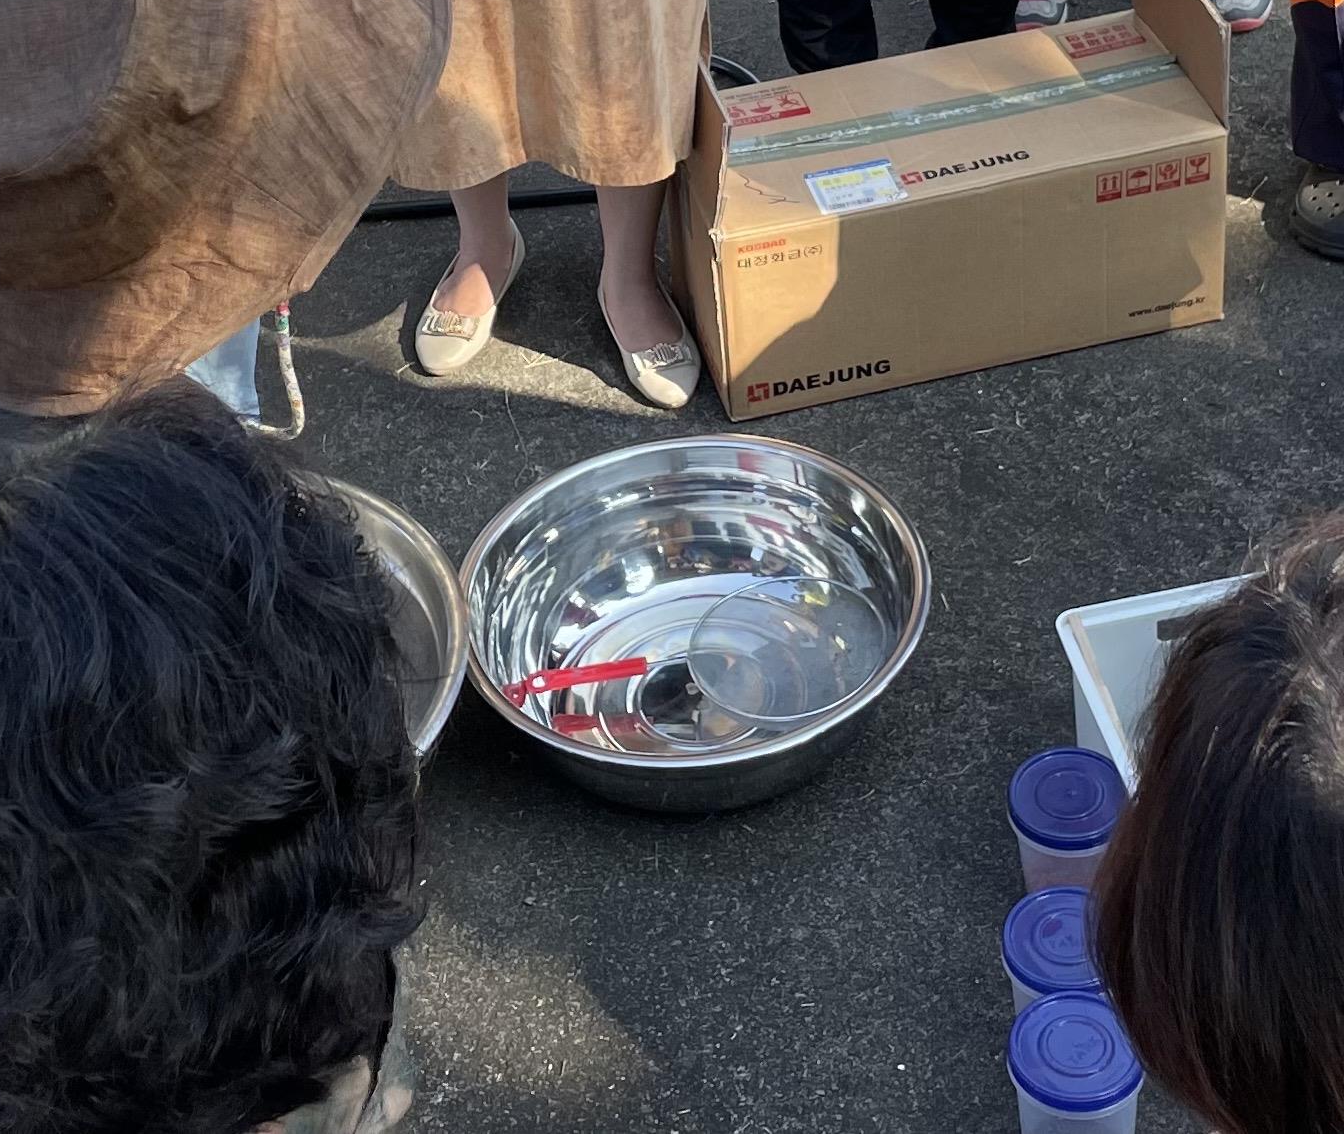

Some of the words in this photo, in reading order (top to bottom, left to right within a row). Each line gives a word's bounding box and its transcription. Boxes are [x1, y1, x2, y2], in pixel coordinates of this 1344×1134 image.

[922, 150, 1031, 181] DAEJUNG
[1127, 296, 1206, 318] www.daejung.kr
[772, 359, 892, 397] DAEJUNG
